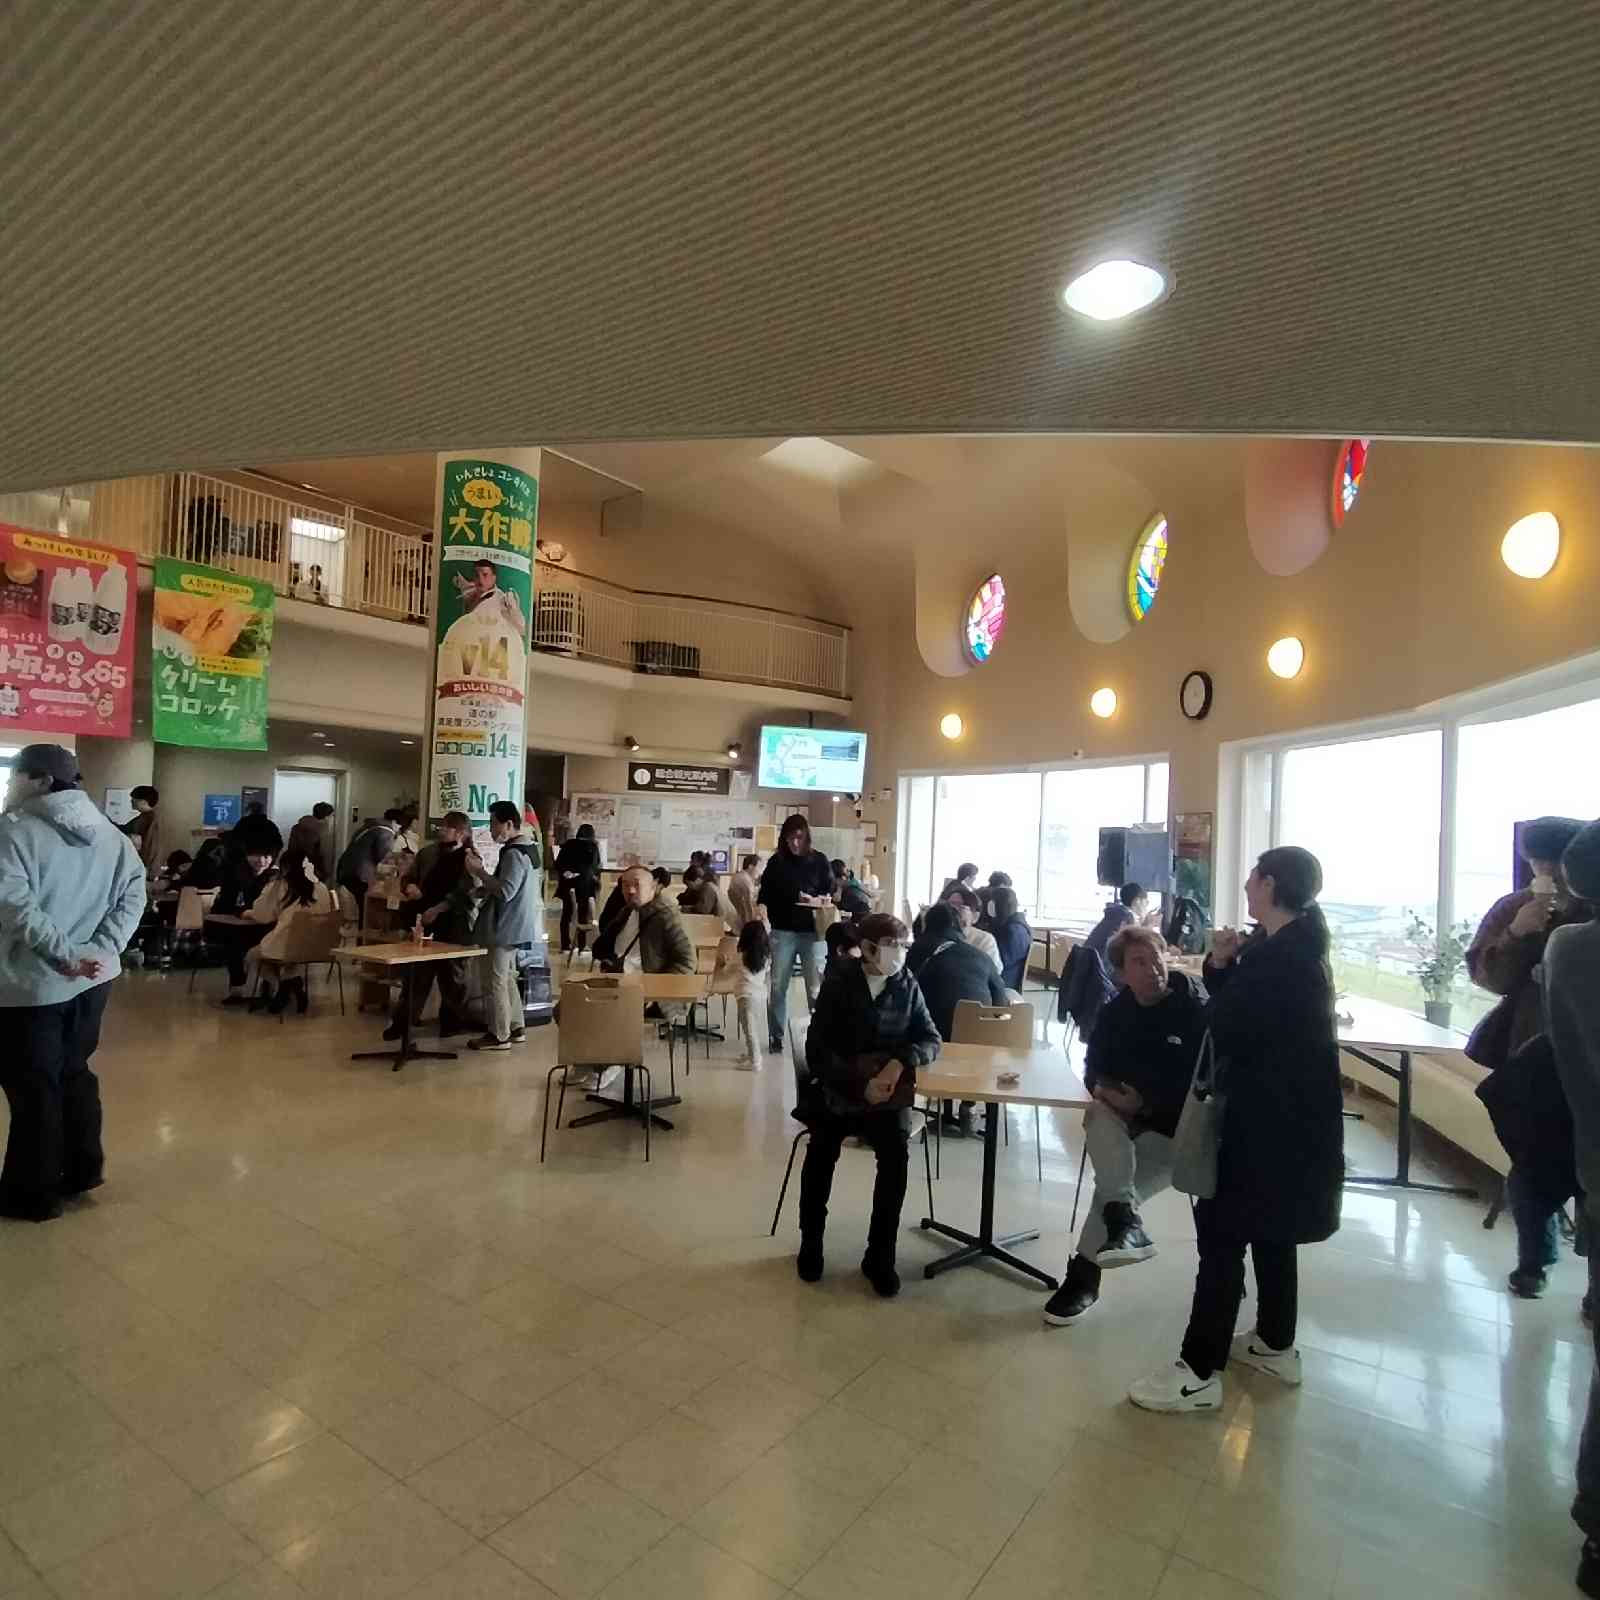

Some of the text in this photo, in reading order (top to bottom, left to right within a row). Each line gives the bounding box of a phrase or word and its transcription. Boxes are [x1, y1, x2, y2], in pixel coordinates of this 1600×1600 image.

[448, 507, 532, 552] 大作
[160, 664, 237, 697] クリーム
[160, 694, 241, 720] コロッケ
[439, 770, 461, 808] 連続
